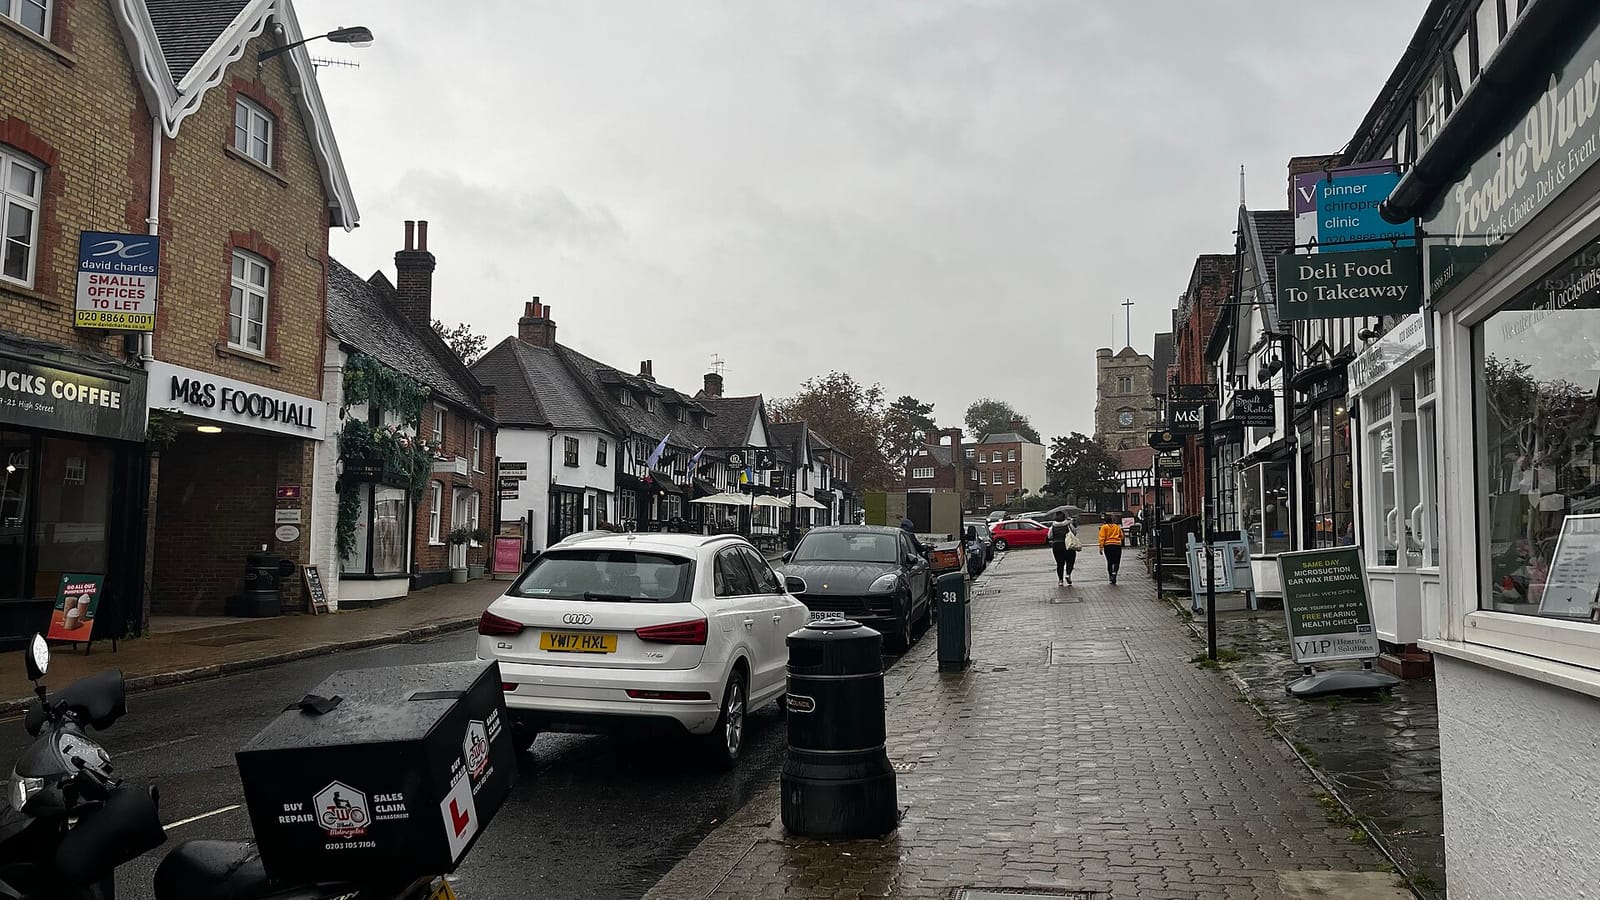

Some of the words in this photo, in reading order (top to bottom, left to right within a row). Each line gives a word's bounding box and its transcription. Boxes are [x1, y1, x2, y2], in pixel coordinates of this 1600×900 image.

[1324, 184, 1368, 199] pinner
[1485, 215, 1507, 247] Chefs
[1507, 193, 1535, 228] Choice
[1536, 169, 1554, 203] Deli
[1555, 160, 1567, 185] &
[1567, 133, 1596, 174] Event
[1324, 200, 1379, 213] chiropra
[1325, 216, 1360, 229] clinic
[82, 259, 111, 270] david
[114, 262, 154, 273] charles
[1299, 262, 1338, 281] Deli
[1344, 258, 1393, 278] Food
[89, 274, 146, 287] SMALLL
[88, 286, 145, 299] OFFICES
[1285, 287, 1308, 304] To
[1313, 284, 1409, 302] Takeaway
[92, 298, 109, 309] TO
[114, 300, 141, 311] LET
[1545, 290, 1556, 315] all
[78, 311, 97, 321] 020
[100, 313, 125, 323] 8866
[128, 314, 152, 325] 0001
[51, 380, 121, 409] COFFEE
[18, 400, 33, 411] High
[34, 403, 54, 413] Street
[170, 375, 216, 408] M&S
[221, 387, 317, 429] FOODHALL
[1174, 410, 1200, 422] M&
[1294, 566, 1351, 577] MICROSUCTION
[1301, 561, 1324, 569] SAME
[1288, 578, 1304, 586] EAR
[1323, 573, 1359, 582] REMOVAL
[942, 591, 957, 603] 38
[1322, 610, 1357, 619] HEARING
[1302, 620, 1331, 628] HEALTH
[1332, 618, 1359, 626] CHECK
[497, 642, 513, 650] Q3
[550, 634, 579, 649] YW17
[582, 635, 608, 649] HXL
[1295, 640, 1331, 655] VIP
[1337, 645, 1374, 653] Solutions
[374, 793, 404, 803] SALES
[283, 802, 303, 812] BUY
[375, 803, 406, 813] CLAIM
[278, 813, 314, 824] REPAIR
[375, 813, 409, 821] MANAGEMENT
[449, 797, 470, 839] L
[359, 840, 376, 848] 7106
